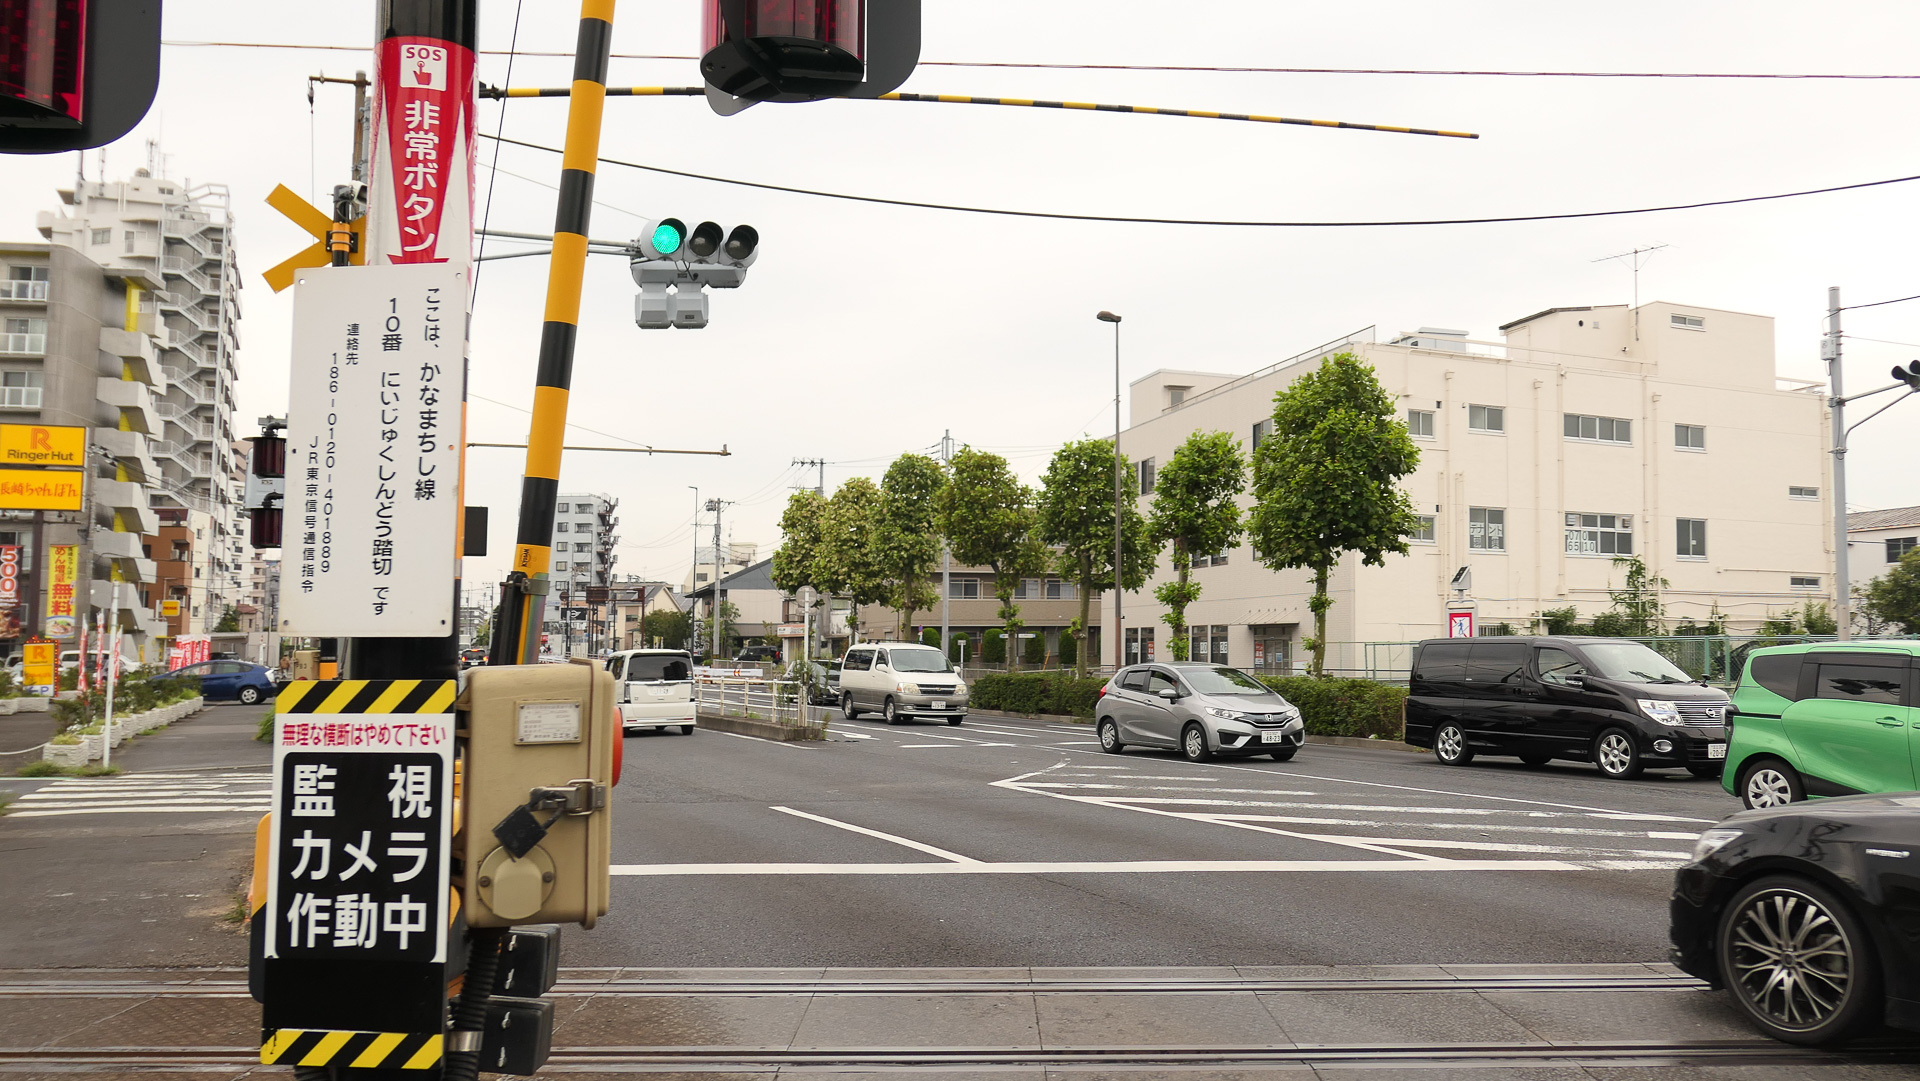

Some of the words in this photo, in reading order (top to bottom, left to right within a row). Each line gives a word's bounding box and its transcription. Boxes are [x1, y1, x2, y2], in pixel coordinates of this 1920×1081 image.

[406, 47, 442, 62] SOS
[403, 100, 441, 252] 非常ボタン
[346, 323, 360, 366] 連絡先
[7, 449, 50, 461] Ringer
[51, 451, 74, 461] Hut
[0, 482, 79, 497] 長崎ちゃんぽん
[301, 436, 319, 593] JR東京信号通信指令
[282, 723, 447, 747] 無理な横断はやめて下さい
[290, 830, 429, 884] カメラ
[286, 893, 427, 950] 作動中
